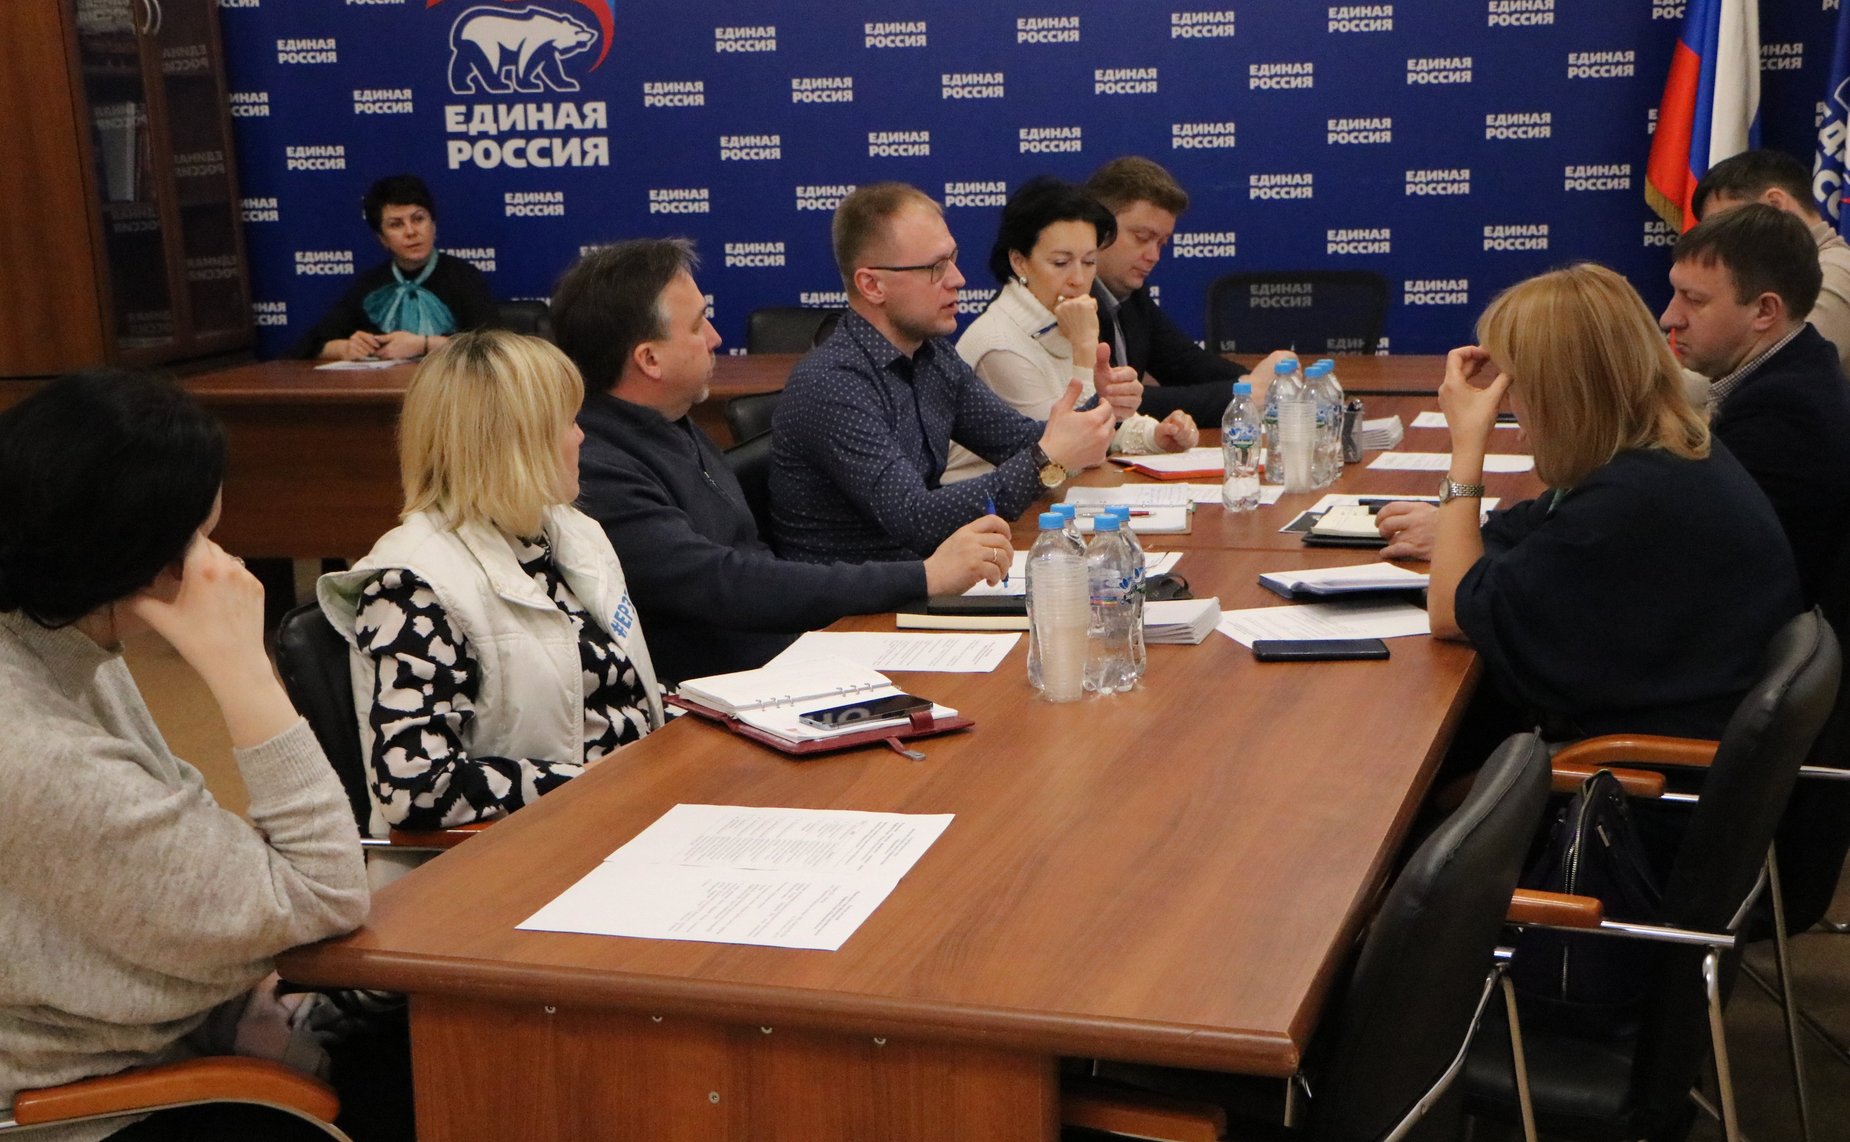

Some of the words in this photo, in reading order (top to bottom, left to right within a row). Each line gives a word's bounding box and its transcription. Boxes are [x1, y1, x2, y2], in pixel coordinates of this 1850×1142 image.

[1329, 5, 1392, 19] ЕДИНАЯ
[1489, 0, 1554, 13] ЕДИНАЯ
[1653, 7, 1685, 19] РОС
[1017, 17, 1079, 30] ЕДИНАЯ
[1172, 11, 1234, 25] ЕДИНАЯ
[1488, 12, 1554, 26] РОССИЯ
[865, 22, 926, 35] ЕДИНАЯ
[1172, 24, 1234, 38] РОССИЯ
[1328, 19, 1392, 32] РОССИЯ
[715, 26, 775, 40] ЕДИНАЯ
[1018, 30, 1079, 43] РОССИЯ
[277, 39, 335, 51] ЕДИНАЯ
[716, 39, 776, 52] РОССИЯ
[866, 35, 926, 48] РОССИЯ
[1759, 43, 1803, 56] ИНАЯ
[278, 51, 337, 63] РОССИЯ
[1569, 51, 1634, 65] ЕДИНАЯ
[1250, 63, 1313, 76] ЕДИНАЯ
[1407, 57, 1472, 71] ЕДИНАЯ
[1759, 57, 1802, 71] ССИЯ
[1095, 68, 1157, 81] ЕДИНАЯ
[1407, 71, 1471, 84] РОССИЯ
[1568, 65, 1634, 78] РОССИЯ
[792, 77, 852, 90] ЕДИНАЯ
[942, 73, 1003, 86] ЕДИНАЯ
[1250, 76, 1313, 89] РОССИЯ
[644, 81, 703, 94] ЕДИНАЯ
[943, 86, 1003, 98] РОССИЯ
[1095, 81, 1157, 94] РОССИЯ
[230, 92, 268, 103] ИНАЯ
[353, 89, 412, 102] ЕДИНАЯ
[645, 94, 704, 107] РОССИЯ
[793, 90, 853, 103] РОССИЯ
[231, 105, 269, 117] ССИЯ
[355, 102, 413, 114] РОССИЯ
[445, 102, 607, 135] ЕДИНАЯ
[1328, 118, 1391, 131] ЕДИНАЯ
[1486, 113, 1551, 126] ЕДИНАЯ
[1020, 127, 1081, 140] ЕДИНАЯ
[1172, 123, 1235, 136] ЕДИНАЯ
[1486, 126, 1550, 139] РОССИЯ
[720, 135, 780, 148] ЕДИНАЯ
[869, 131, 929, 144] ЕДИНАЯ
[1173, 136, 1235, 148] РОССИЯ
[1328, 131, 1391, 144] РОССИЯ
[286, 146, 344, 158] ЕДИНАЯ
[448, 137, 609, 169] РОССИЯ
[869, 144, 929, 156] РОССИЯ
[1020, 140, 1081, 153] РОССИЯ
[721, 148, 780, 160] РОССИЯ
[287, 158, 345, 170] РОССИЯ
[1406, 169, 1470, 183] ЕДИНАЯ
[1565, 165, 1630, 178] ЕДИНАЯ
[1250, 174, 1312, 187] ЕДИНАЯ
[1565, 178, 1630, 191] РОССИЯ
[945, 182, 1006, 194] ЕДИНАЯ
[1250, 187, 1312, 199] РОССИЯ
[1406, 182, 1469, 195] РОССИЯ
[505, 192, 563, 204] ЕДИНАЯ
[650, 189, 708, 201] ЕДИНАЯ
[945, 194, 1006, 207] РОССИЯ
[242, 198, 277, 209] ИНАЯ
[506, 204, 564, 216] РОССИЯ
[650, 201, 709, 213] РОССИЯ
[797, 198, 840, 211] РОСС
[243, 210, 279, 221] ССИЯ
[1327, 229, 1390, 242] ЕДИНАЯ
[1484, 225, 1548, 238] ЕДИНАЯ
[1173, 232, 1235, 245] ЕДИНАЯ
[1484, 238, 1548, 250] РОССИЯ
[439, 248, 495, 259] ДИНАЯ
[725, 242, 784, 255] ЕДИНАЯ
[1174, 245, 1235, 257] РОССИЯ
[1327, 242, 1390, 254] РОССИЯ
[295, 251, 352, 263] ЕДИНАЯ
[726, 255, 785, 266] РОССИЯ
[296, 263, 354, 275] РОССИЯ
[1250, 284, 1312, 295] ЕДИНАЯ
[1405, 280, 1468, 292] ЕДИНАЯ
[800, 292, 848, 304] ЕДИНА
[1250, 296, 1312, 308] РОССИЯ
[1405, 293, 1467, 304] РОССИЯ
